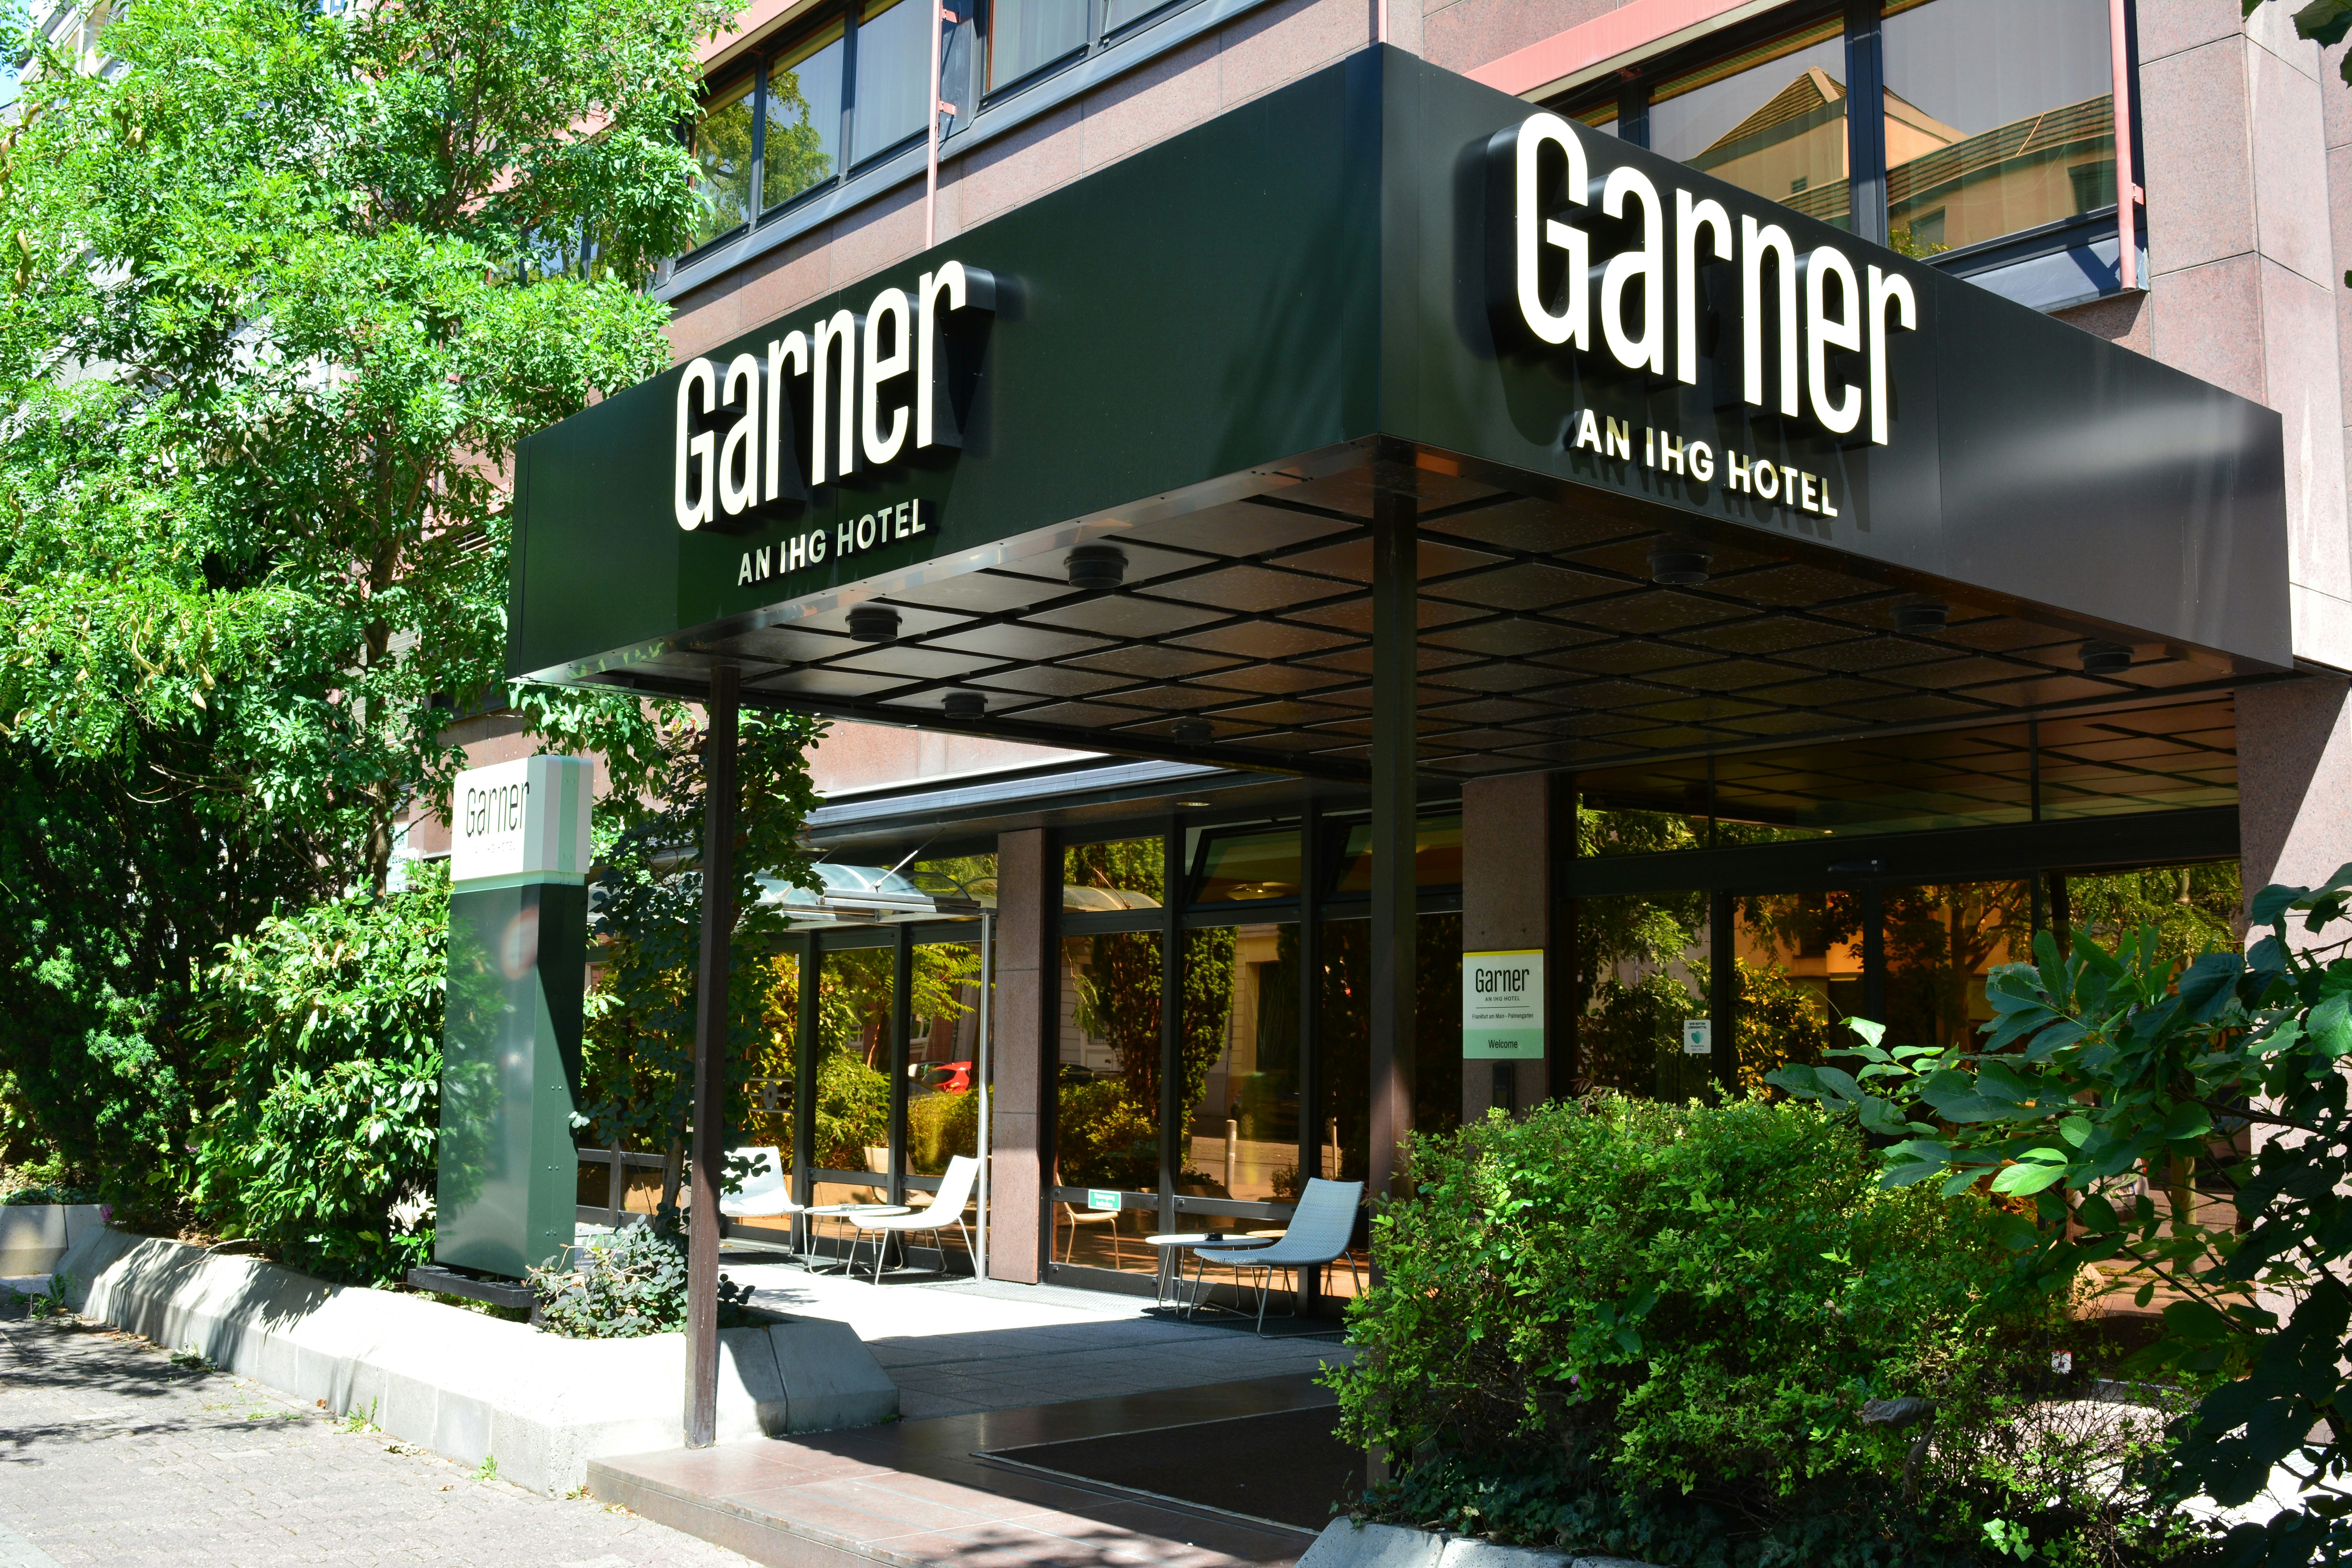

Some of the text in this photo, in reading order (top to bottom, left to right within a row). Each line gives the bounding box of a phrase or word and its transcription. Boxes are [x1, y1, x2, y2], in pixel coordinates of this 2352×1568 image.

[1516, 113, 1916, 445] Garner
[675, 260, 966, 531] Garner
[1576, 408, 1838, 517] AN IHG HOTEL
[737, 498, 926, 586] AN IHG HOTEL
[466, 781, 530, 838] Garner
[1475, 968, 1530, 993] Garner
[1488, 1039, 1518, 1048] Welcome
